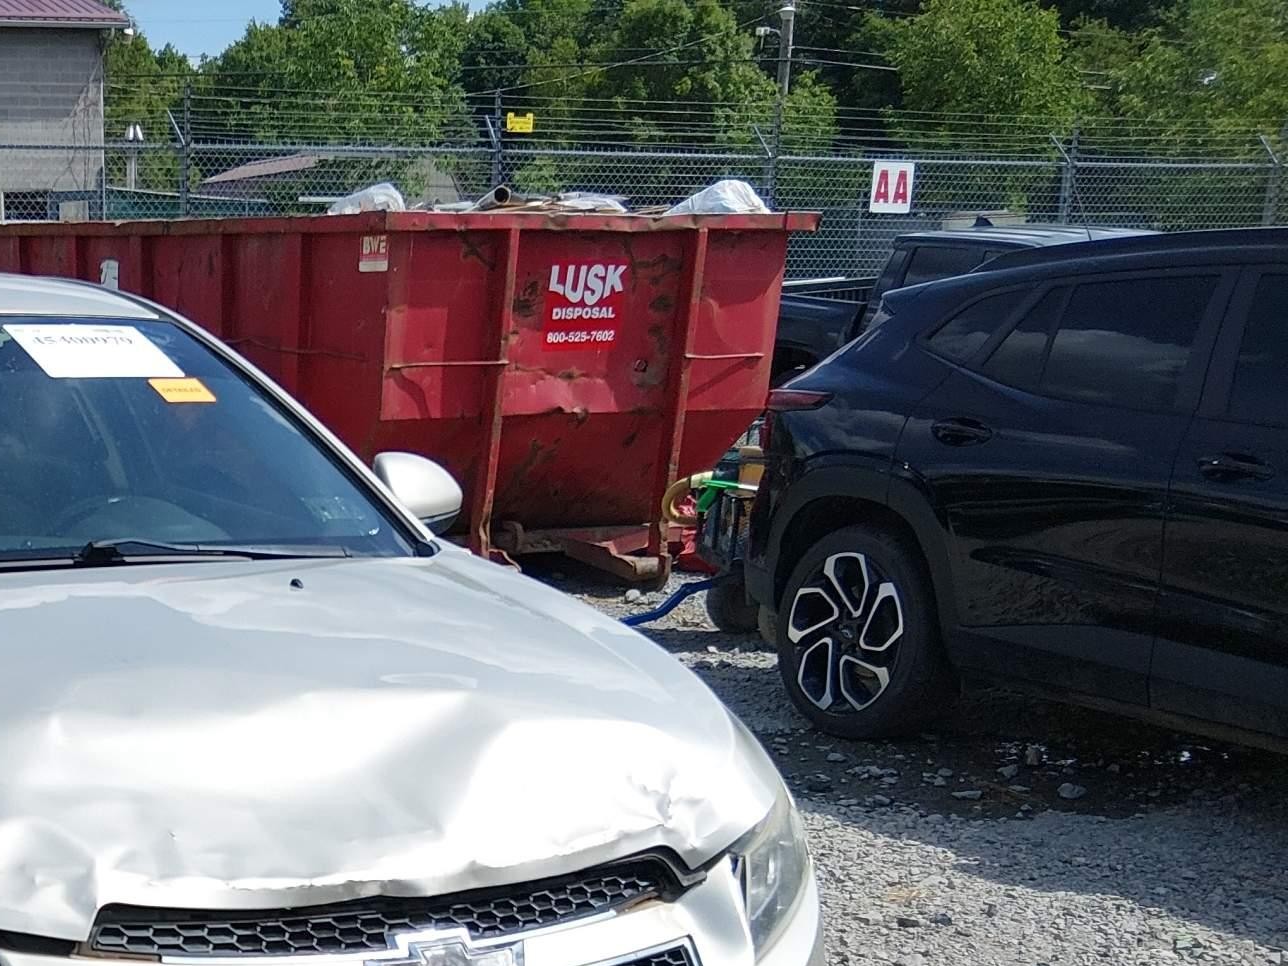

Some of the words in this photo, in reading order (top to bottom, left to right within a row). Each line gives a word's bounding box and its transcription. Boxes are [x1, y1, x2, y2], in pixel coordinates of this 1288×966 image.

[873, 169, 908, 204] AA
[548, 264, 627, 305] LUSK
[552, 306, 616, 320] DISPOSAL
[546, 330, 615, 343] 800-525-7602
